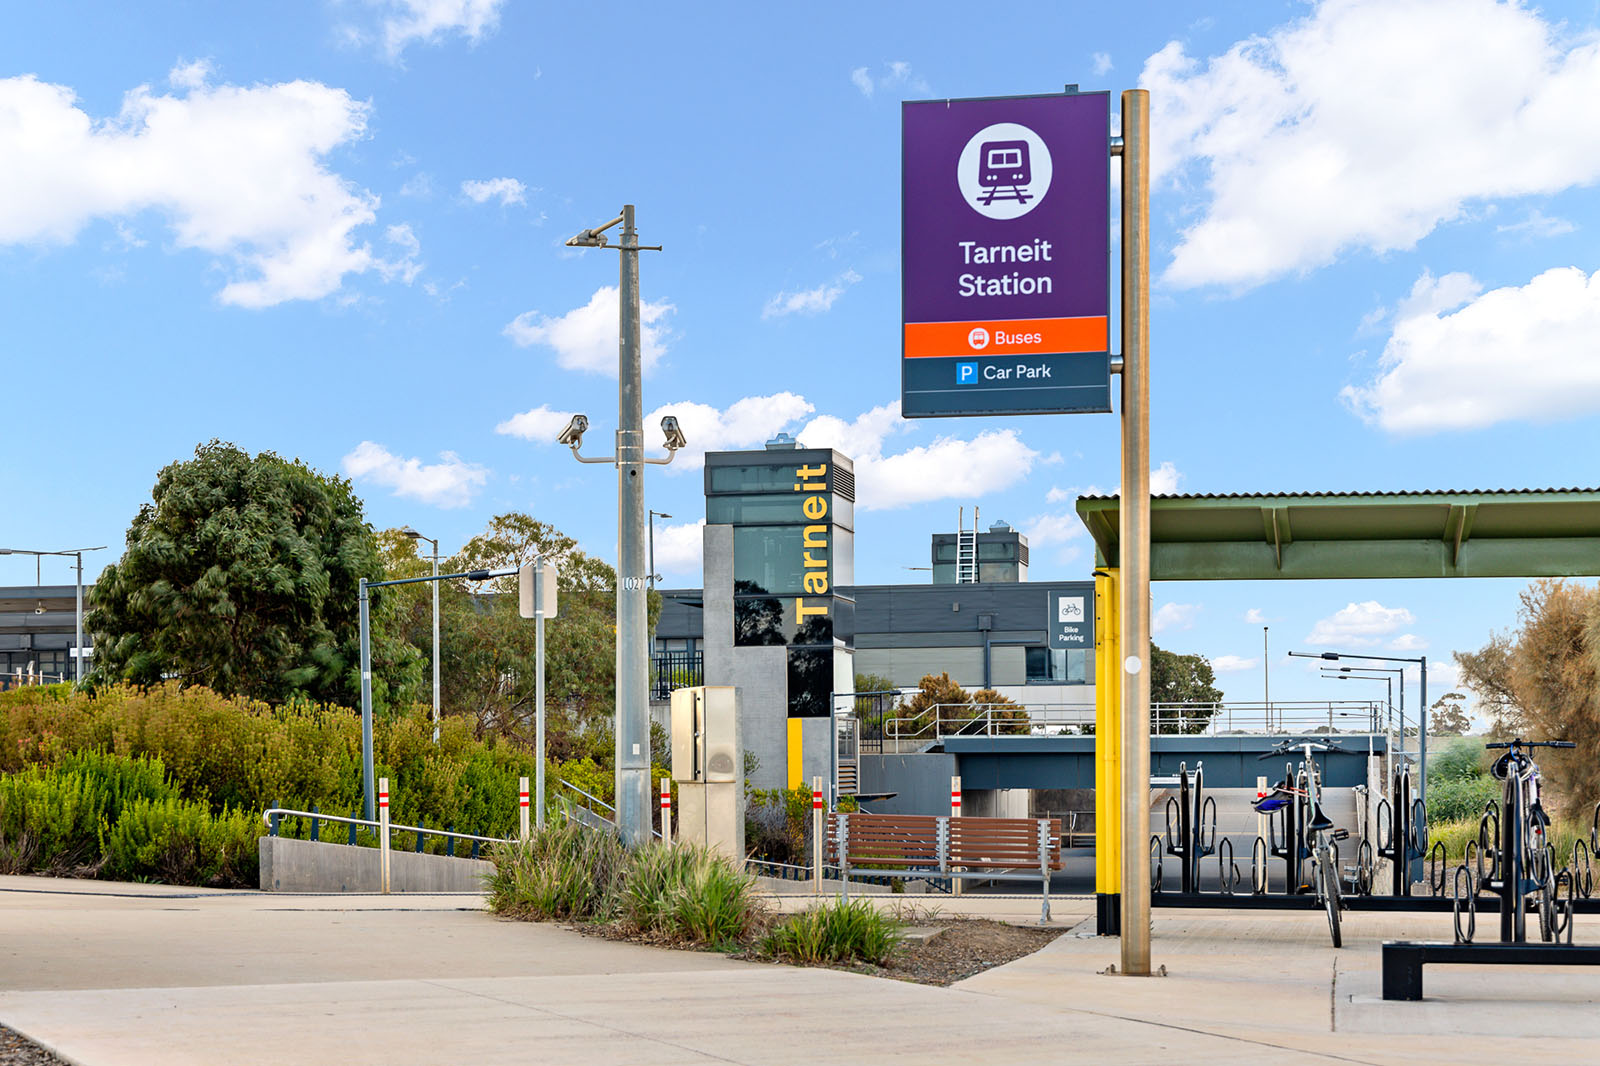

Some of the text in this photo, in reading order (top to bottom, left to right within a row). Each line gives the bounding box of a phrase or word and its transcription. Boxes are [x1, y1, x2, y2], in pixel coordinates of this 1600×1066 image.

[958, 238, 1052, 264] Tarneit
[958, 271, 1053, 297] Station
[995, 331, 1042, 345] Buses
[961, 363, 1052, 382] P Car Park
[794, 463, 828, 625] Tarneit
[1058, 634, 1084, 643] Parking
[1064, 626, 1079, 634] Bike
